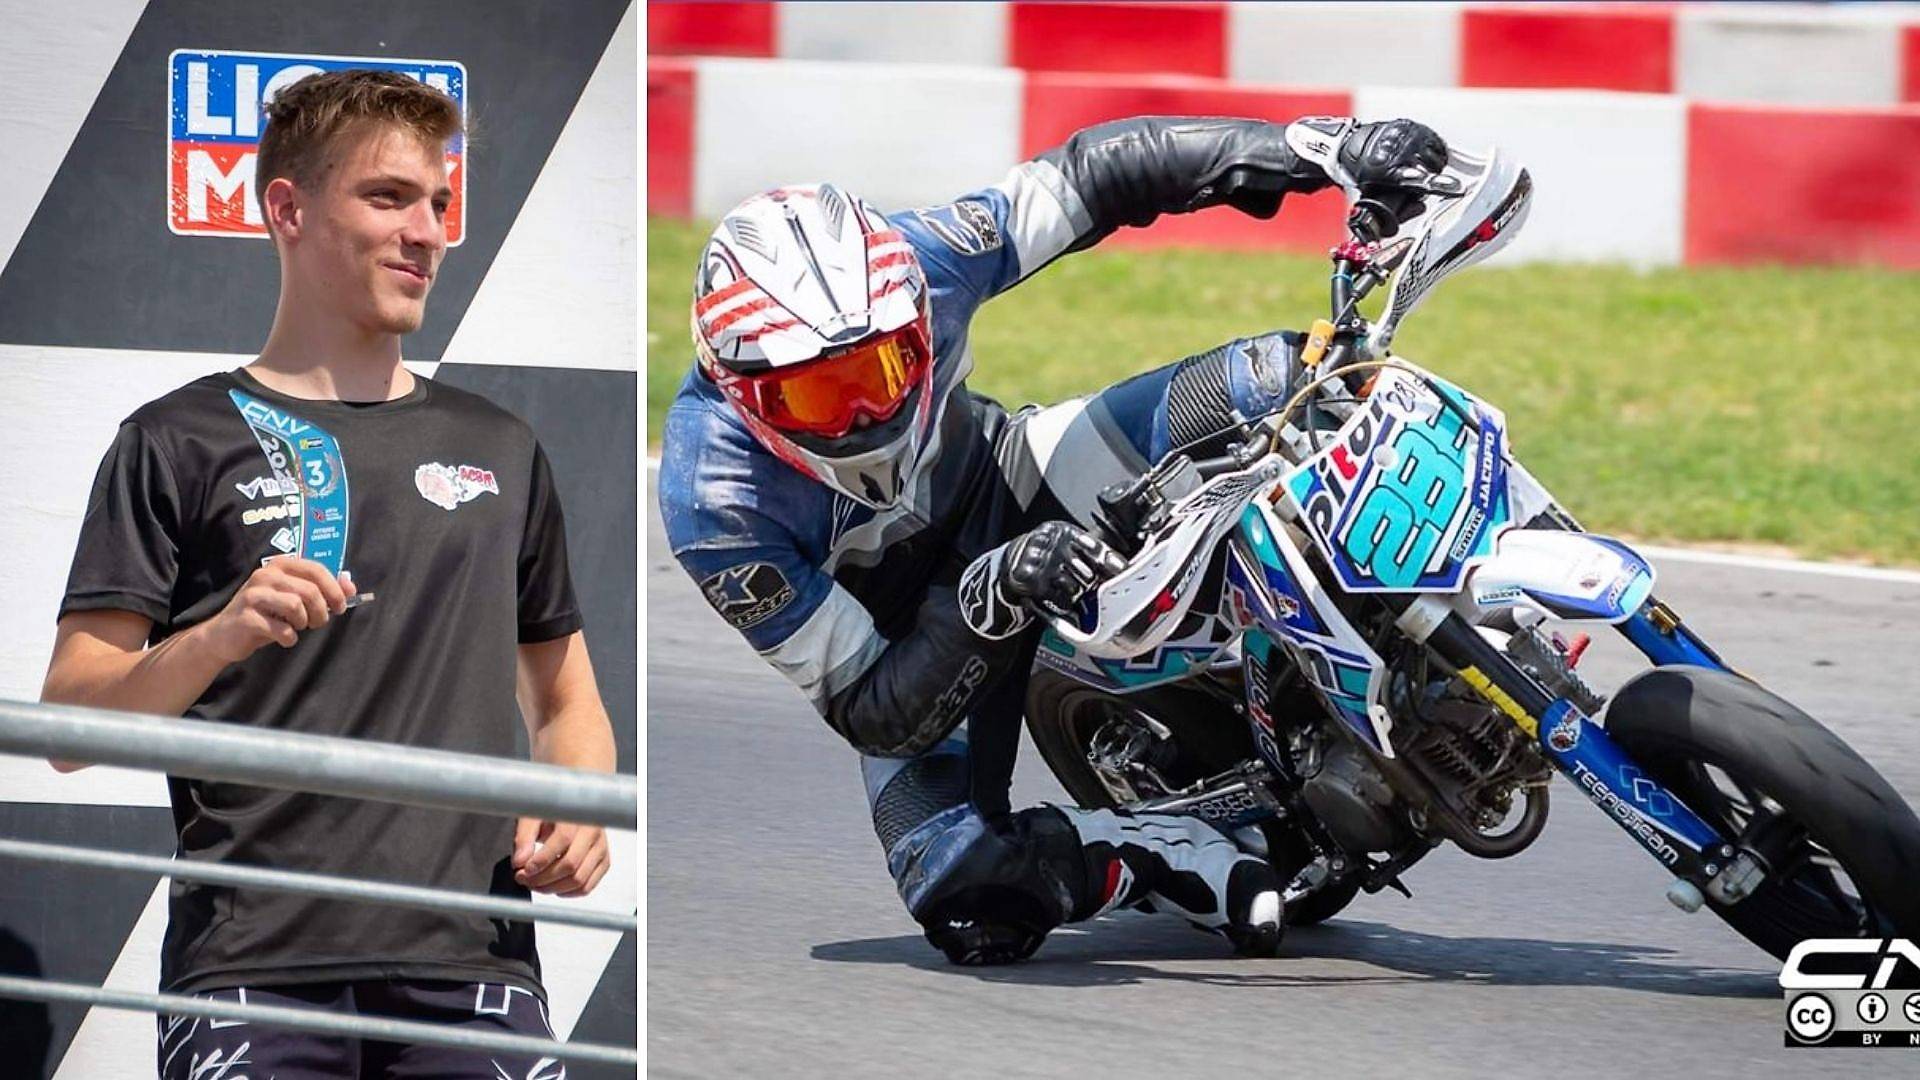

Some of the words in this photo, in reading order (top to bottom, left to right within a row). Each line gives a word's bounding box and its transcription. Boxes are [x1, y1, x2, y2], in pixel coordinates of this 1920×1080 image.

[242, 401, 311, 435] CNV
[305, 459, 326, 487] 3
[1479, 431, 1496, 508] JACOPO
